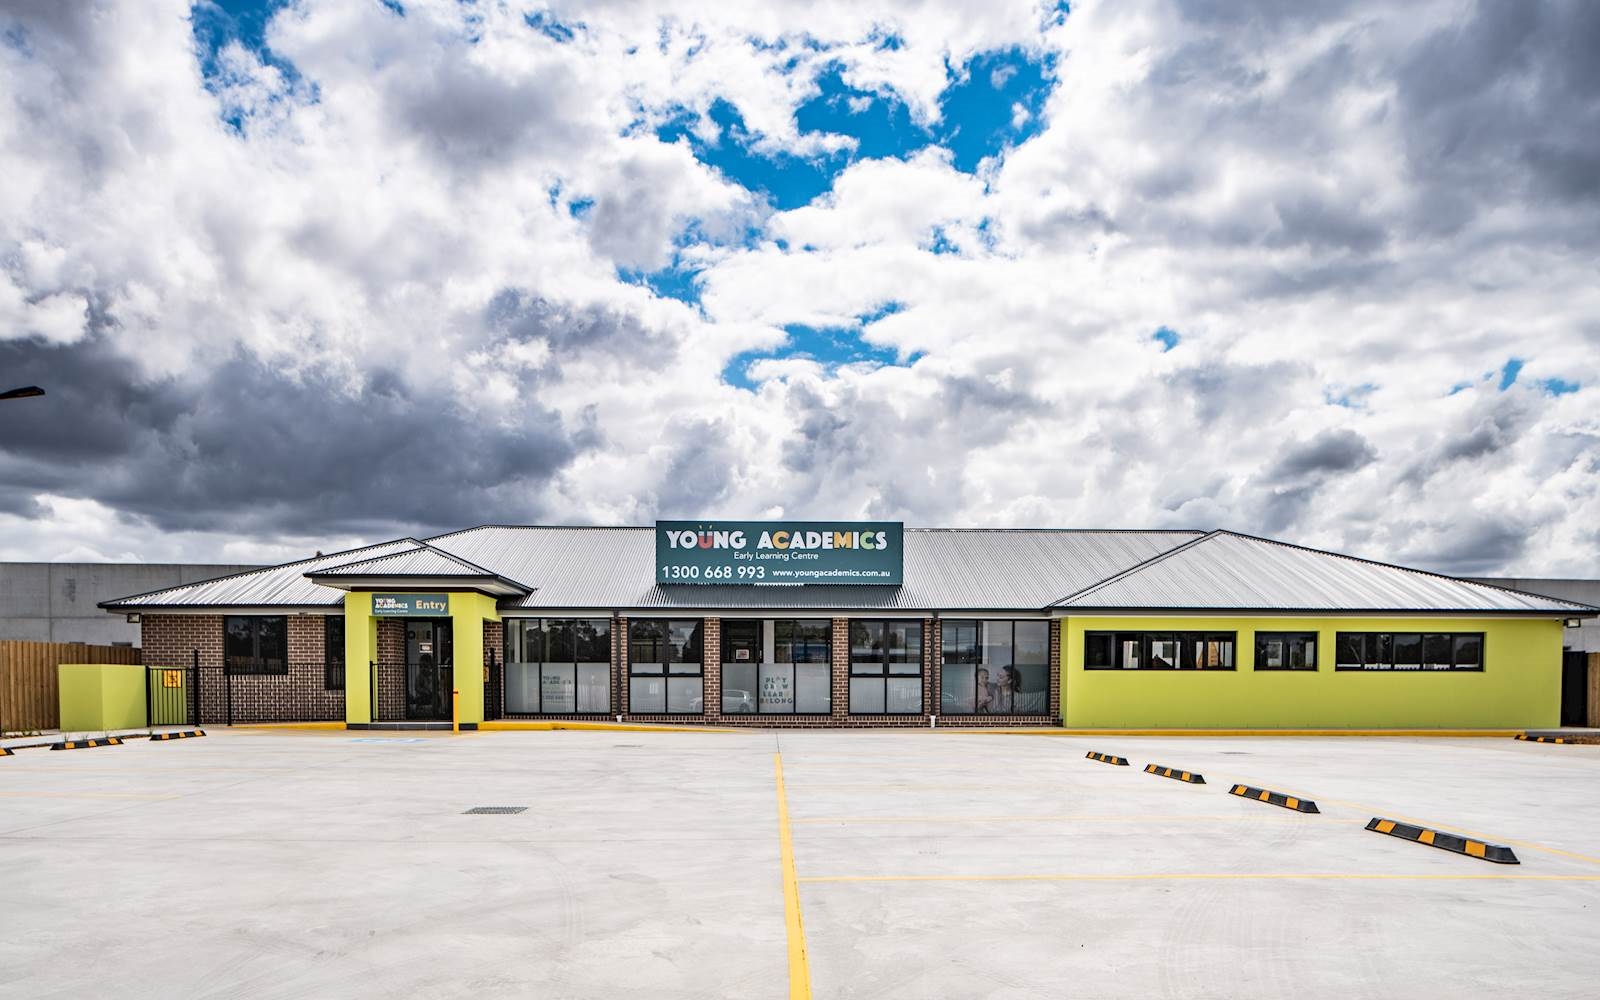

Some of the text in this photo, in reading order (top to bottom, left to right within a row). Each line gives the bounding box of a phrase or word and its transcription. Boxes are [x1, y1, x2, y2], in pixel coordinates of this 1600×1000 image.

[756, 530, 888, 551] ACADEMICS
[733, 551, 819, 562] Early Learning Centre
[662, 565, 891, 579] 1300 668 993 www.youngacademics.com.au
[415, 600, 447, 612] Entry
